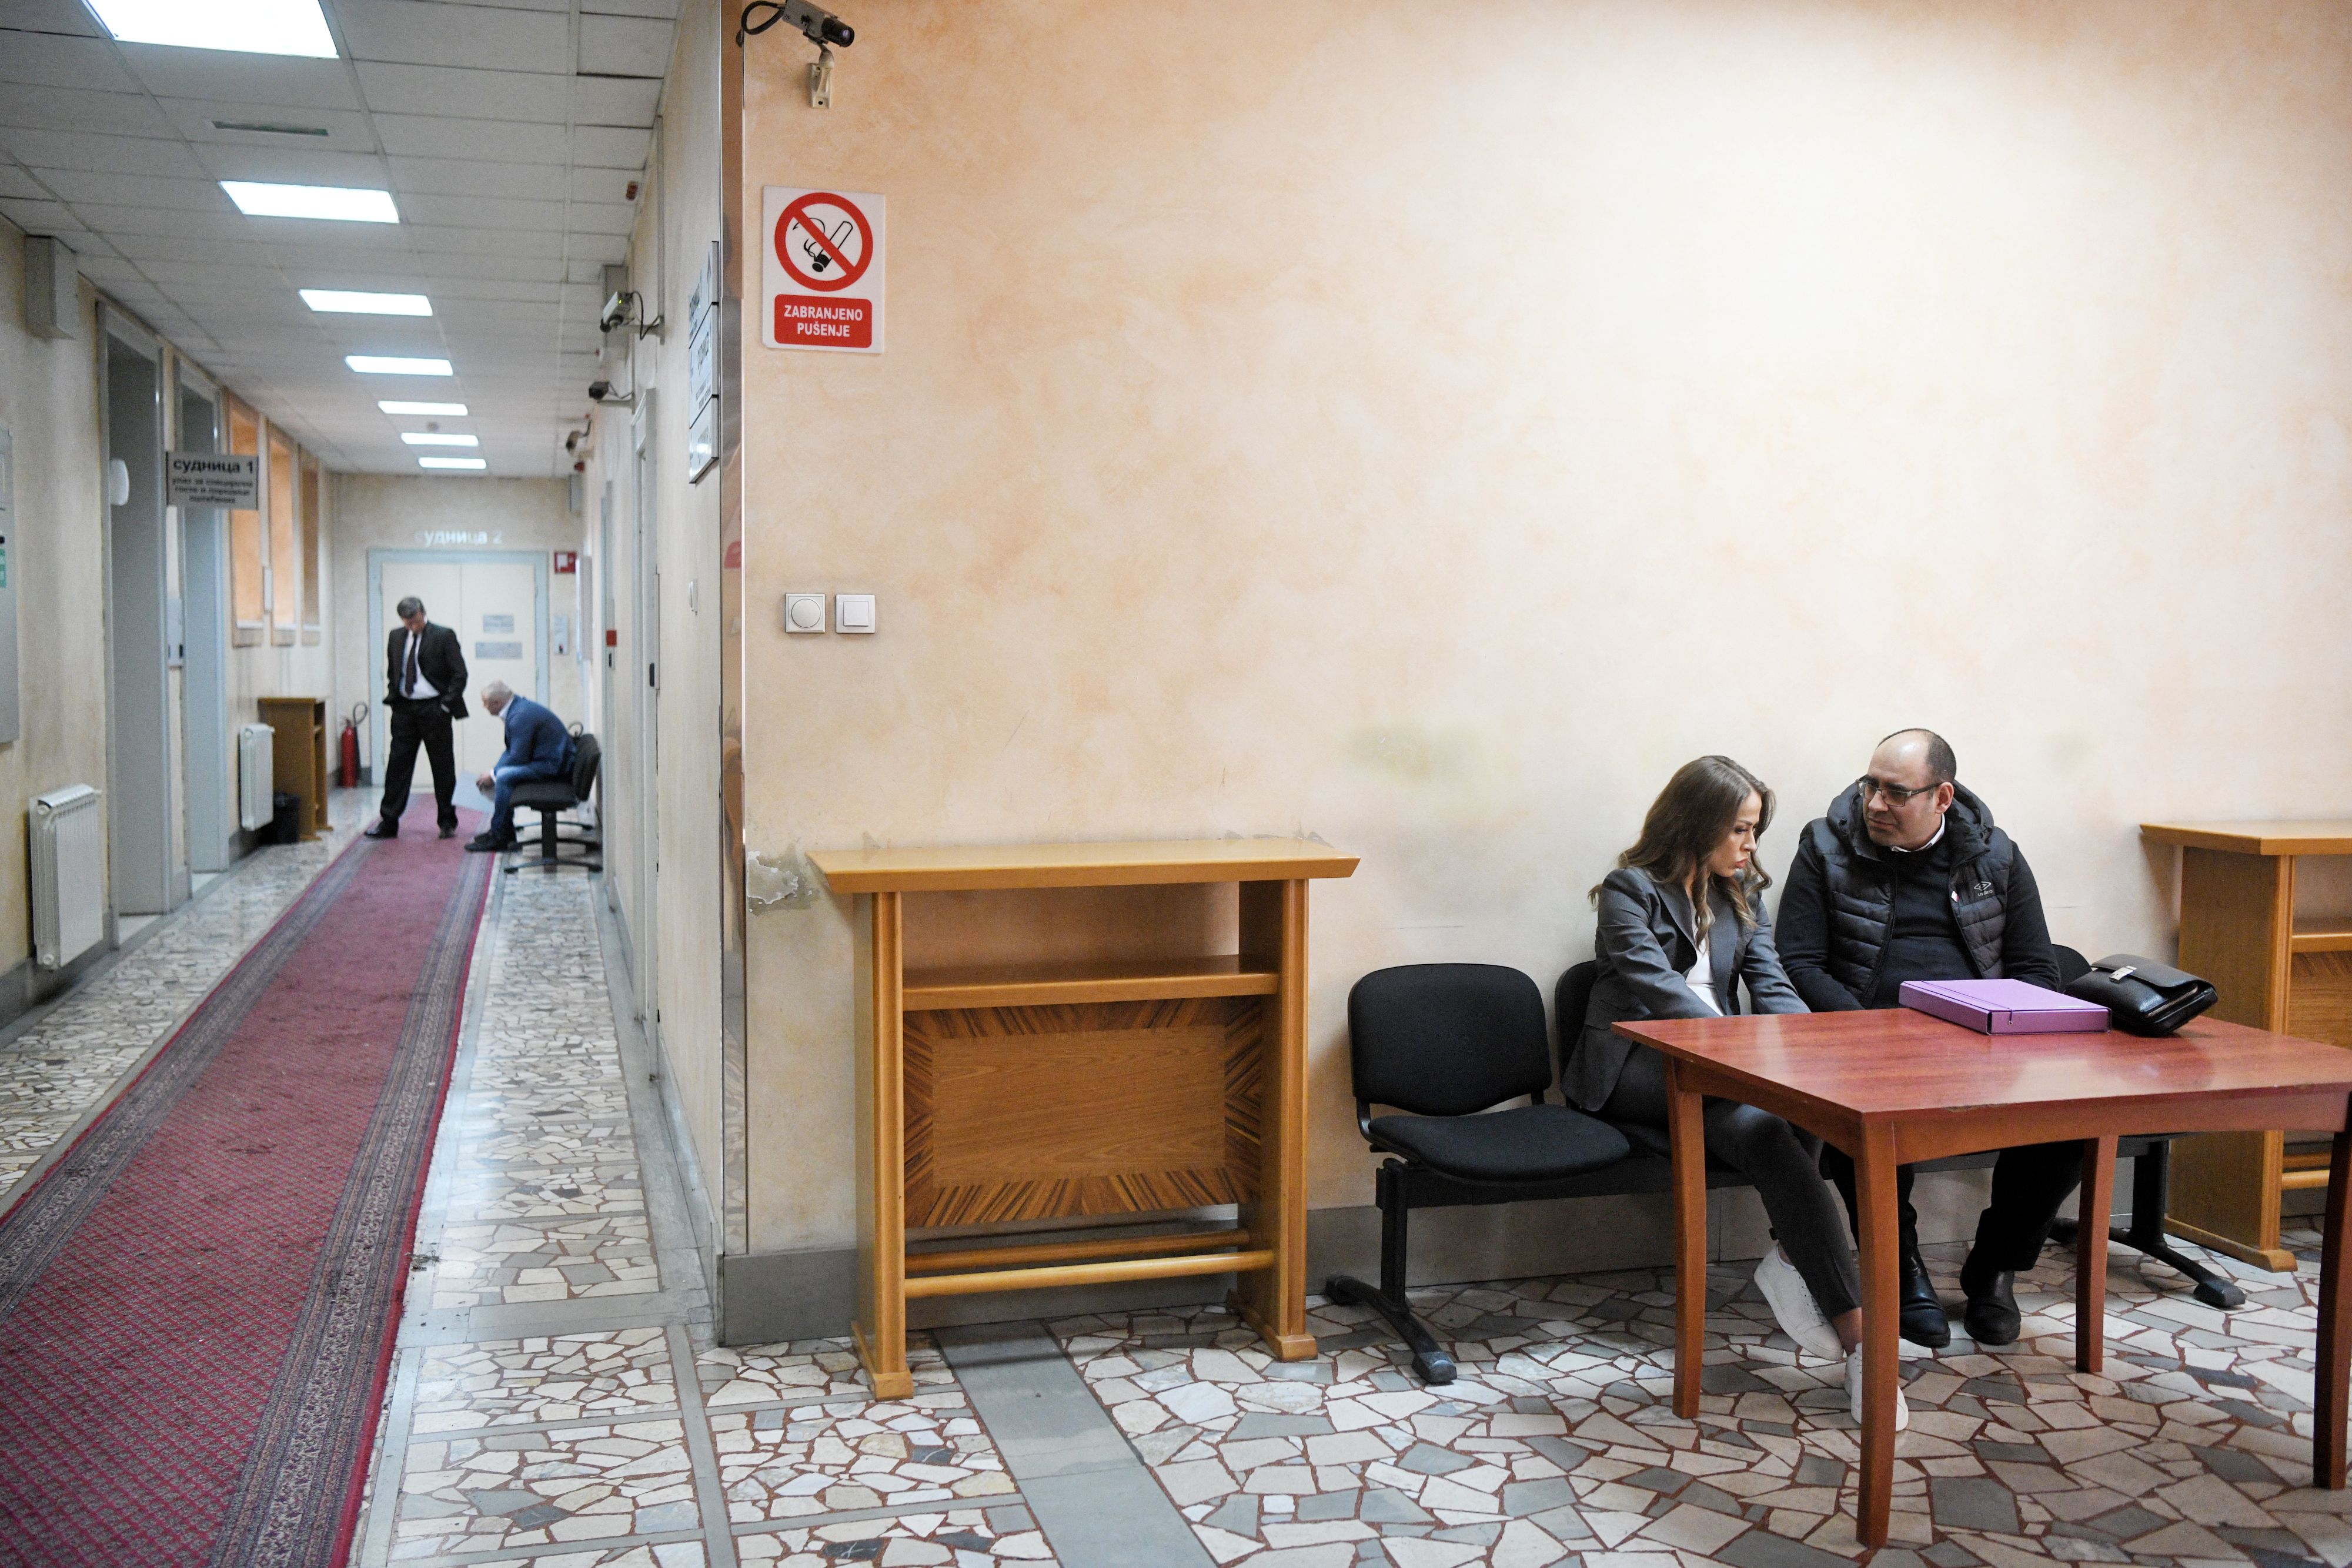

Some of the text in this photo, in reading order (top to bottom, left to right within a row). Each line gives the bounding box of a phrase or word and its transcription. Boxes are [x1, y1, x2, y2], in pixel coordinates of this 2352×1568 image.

[784, 305, 863, 322] ZABRANJENO
[797, 321, 851, 337] PUŠENJE
[173, 459, 253, 474] судница 1
